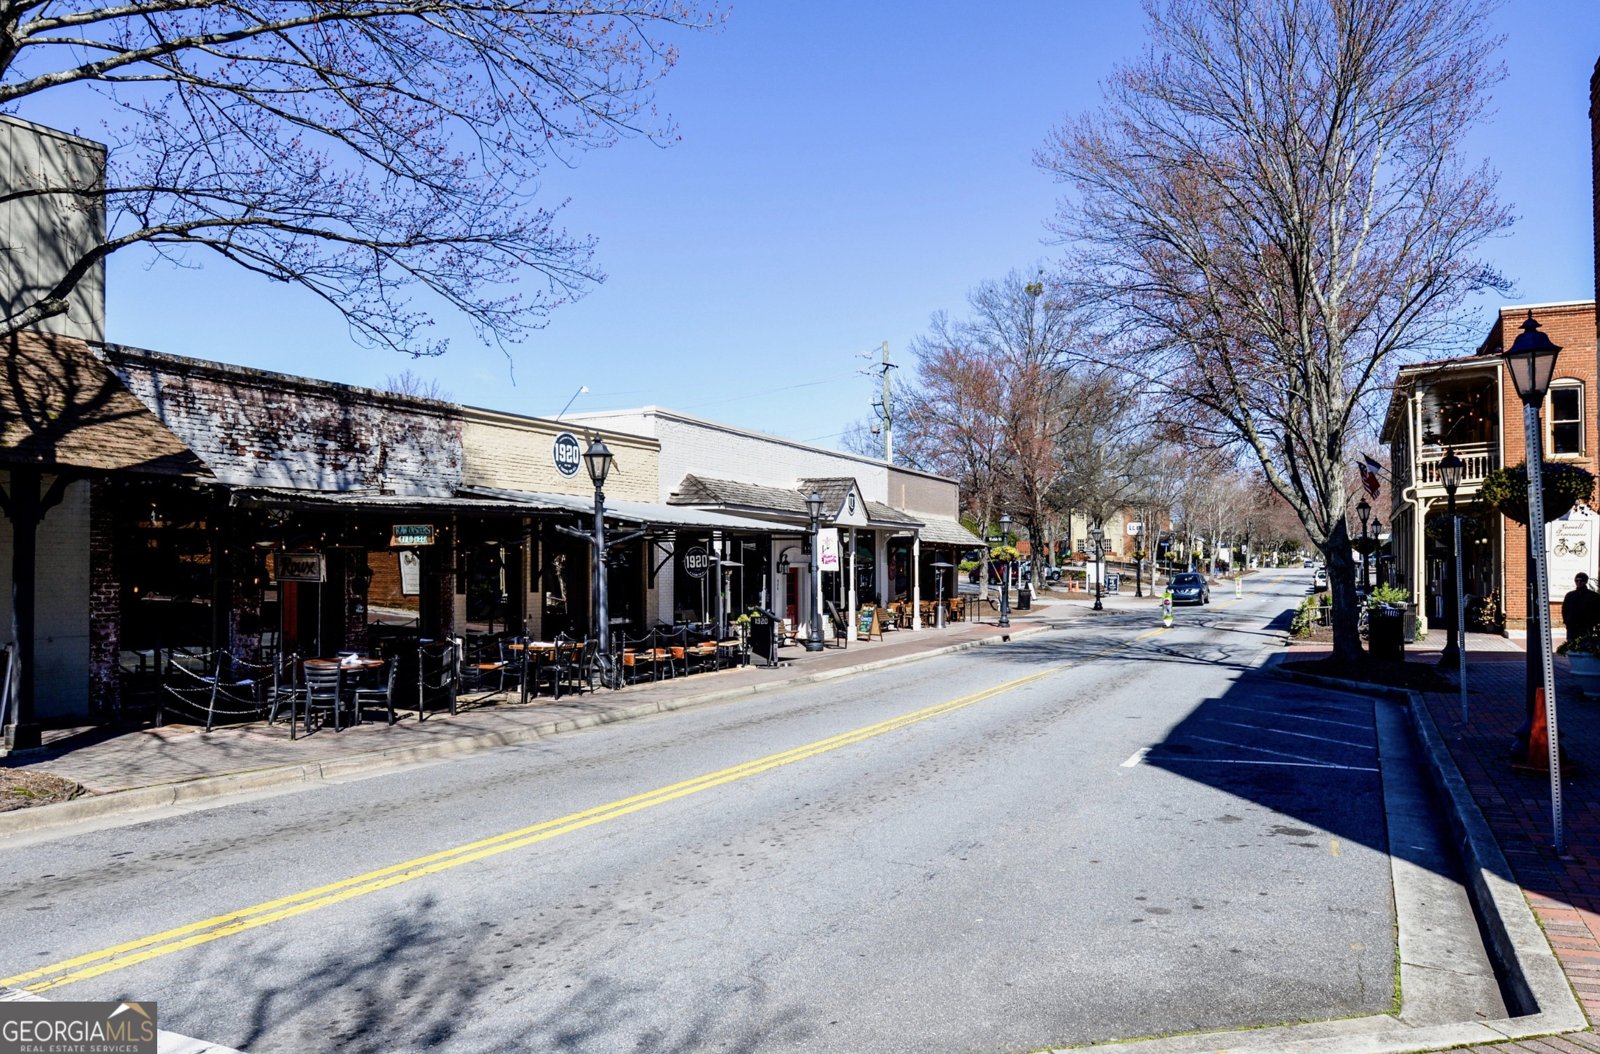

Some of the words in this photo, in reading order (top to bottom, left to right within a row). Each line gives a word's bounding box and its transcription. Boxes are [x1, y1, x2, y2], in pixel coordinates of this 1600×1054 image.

[555, 443, 579, 464] 1920
[281, 556, 315, 576] Roux
[686, 554, 708, 569] 1920
[754, 617, 769, 625] 1920
